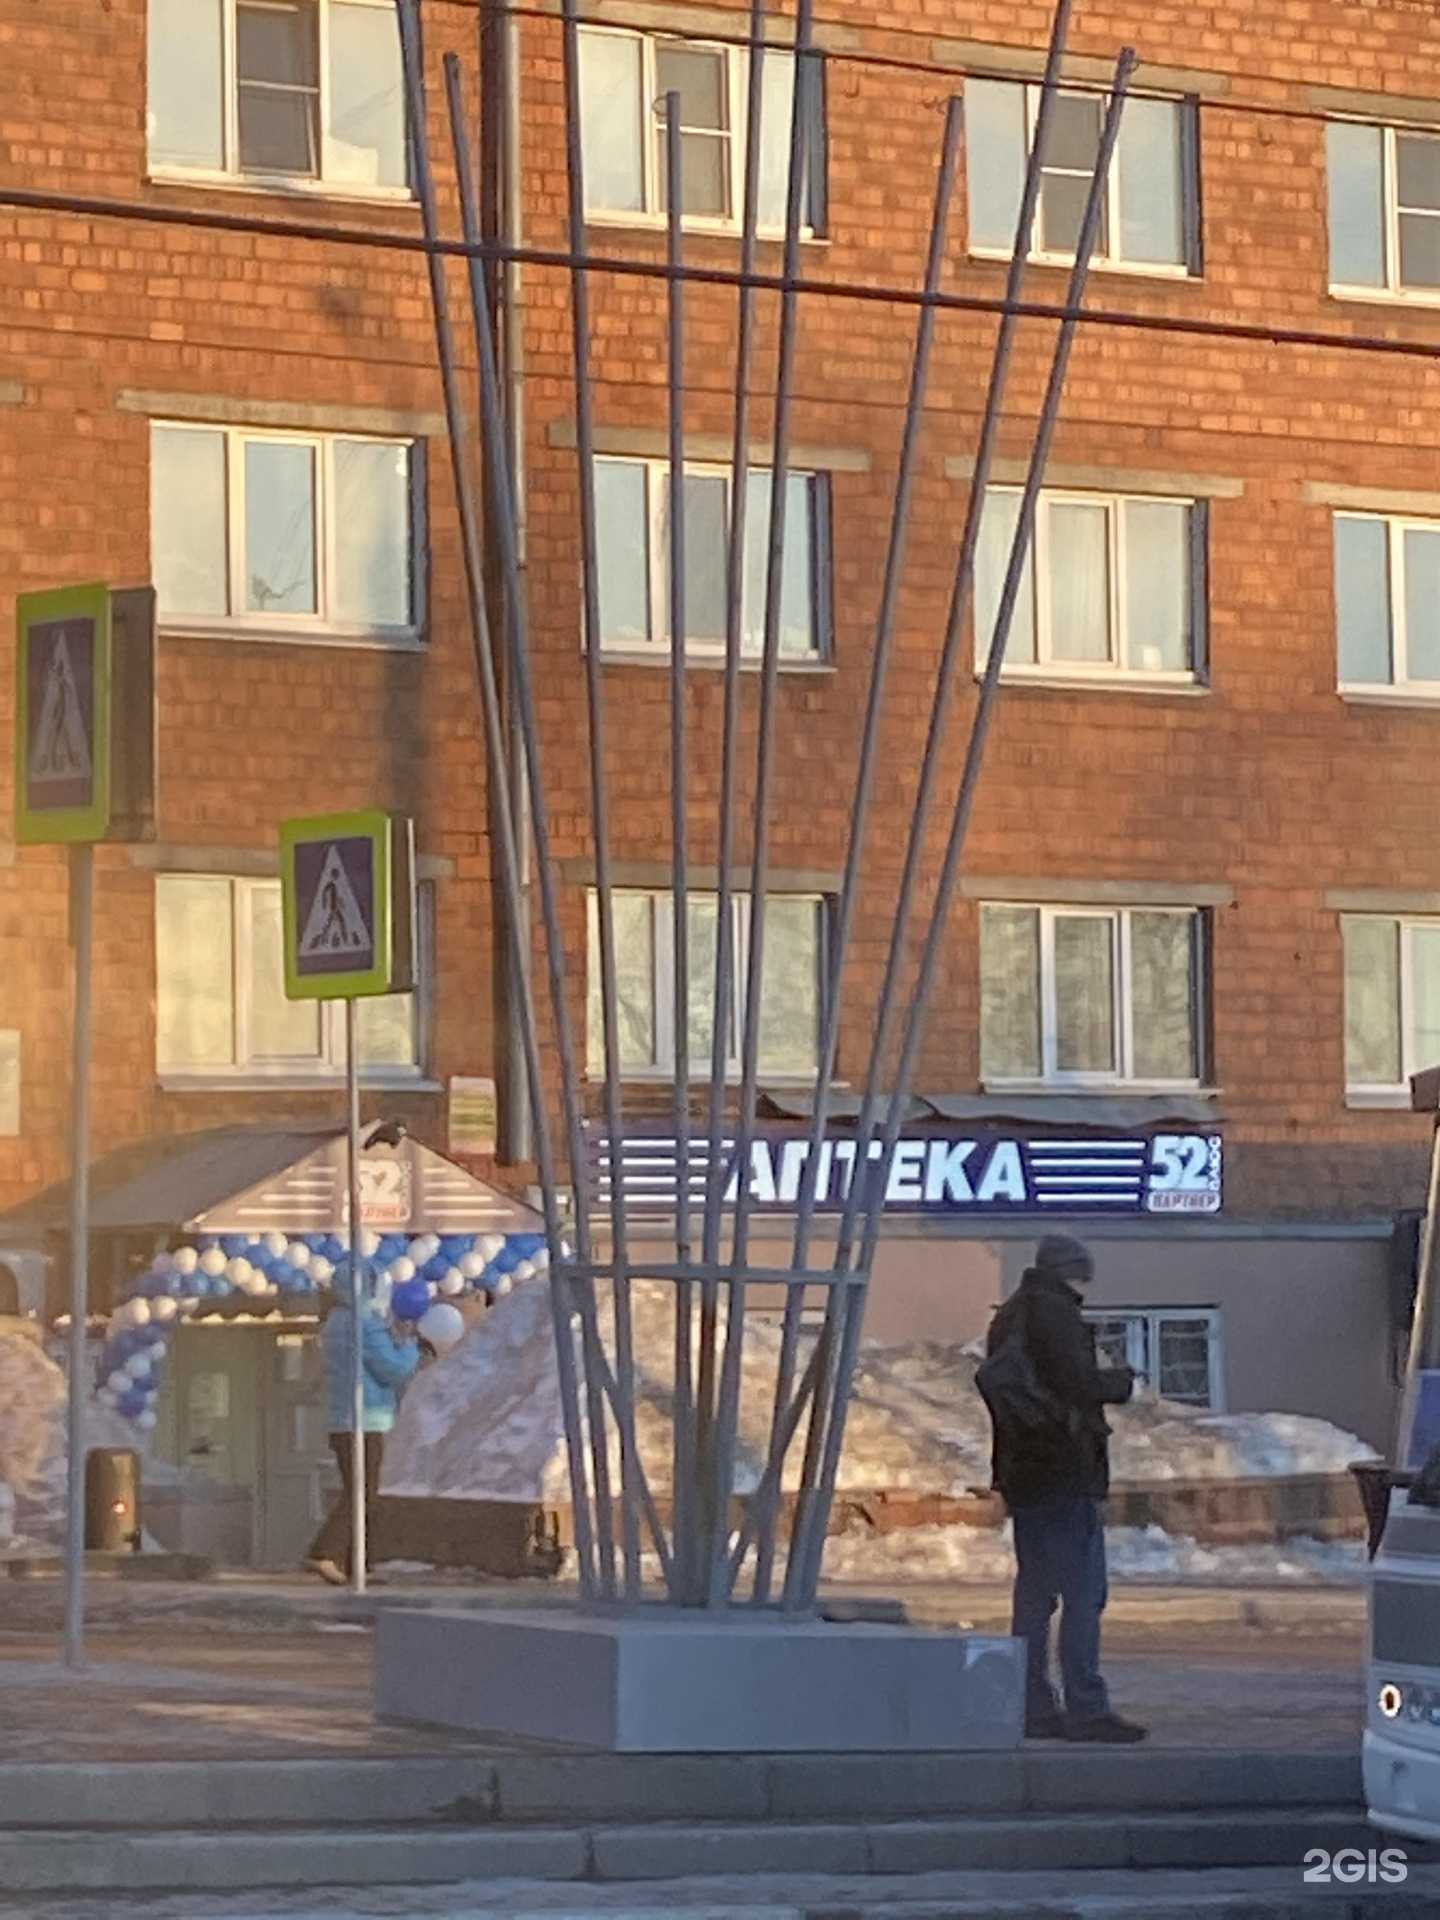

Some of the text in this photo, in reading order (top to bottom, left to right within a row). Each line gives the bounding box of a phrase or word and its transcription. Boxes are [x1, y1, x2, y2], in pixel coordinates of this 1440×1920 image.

[722, 1141, 1026, 1201] АПТЕКА
[1149, 1136, 1208, 1190] 52
[1152, 1193, 1217, 1208] ПАРТНЕР
